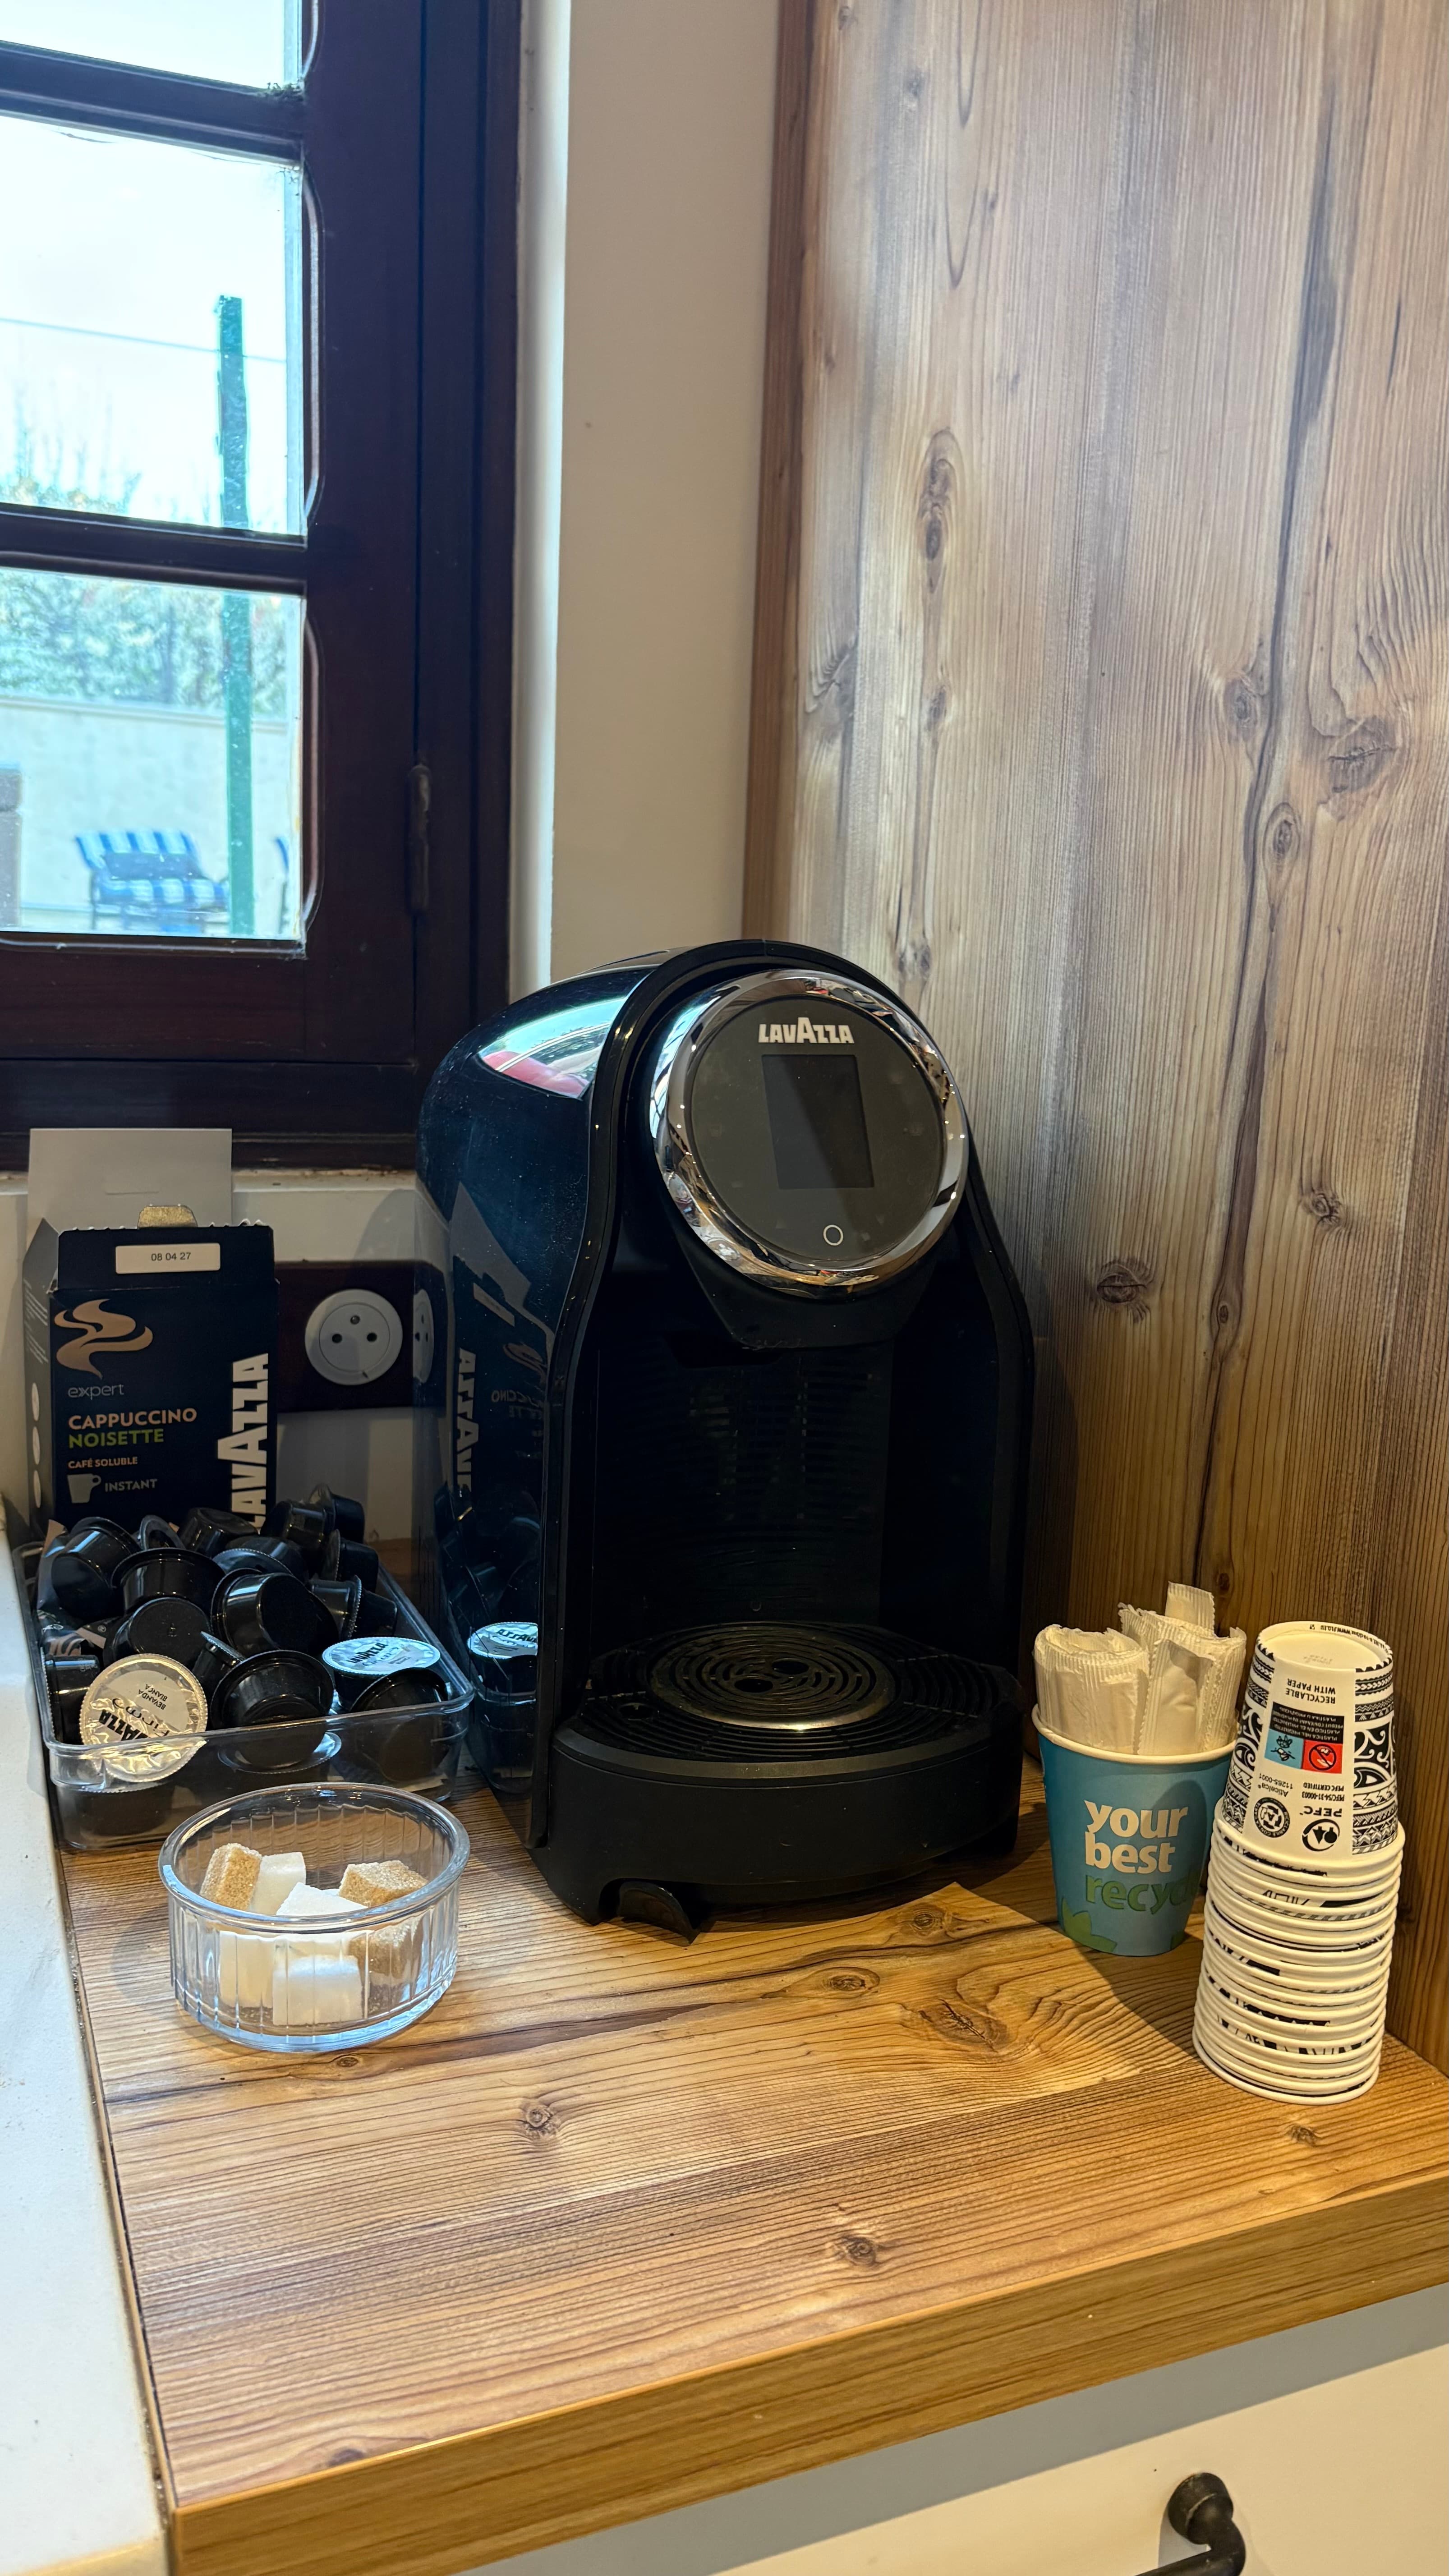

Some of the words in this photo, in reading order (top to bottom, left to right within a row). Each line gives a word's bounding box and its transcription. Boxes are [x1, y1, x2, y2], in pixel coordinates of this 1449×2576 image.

[758, 1017, 855, 1044] LAVAZZA
[151, 1253, 162, 1261] 08
[166, 1252, 177, 1261] 04
[180, 1252, 191, 1260] 27
[68, 1384, 124, 1400] expert
[68, 1408, 197, 1430] CAPPUCCINO
[69, 1428, 164, 1449] NOISETTE
[68, 1458, 93, 1469] CAFÉ
[94, 1456, 138, 1467] SOLUBLE
[105, 1479, 157, 1492] INSTANT
[1287, 1678, 1312, 1691] PAPER
[1314, 1685, 1336, 1695] WITH
[138, 1689, 167, 1710] BEVANDA
[145, 1684, 168, 1702] BIANCA
[1285, 1688, 1336, 1704] RECYCLABLE
[1303, 1782, 1330, 1791] CERTIFIED
[1084, 1800, 1189, 1839] your
[1085, 1831, 1176, 1874] best
